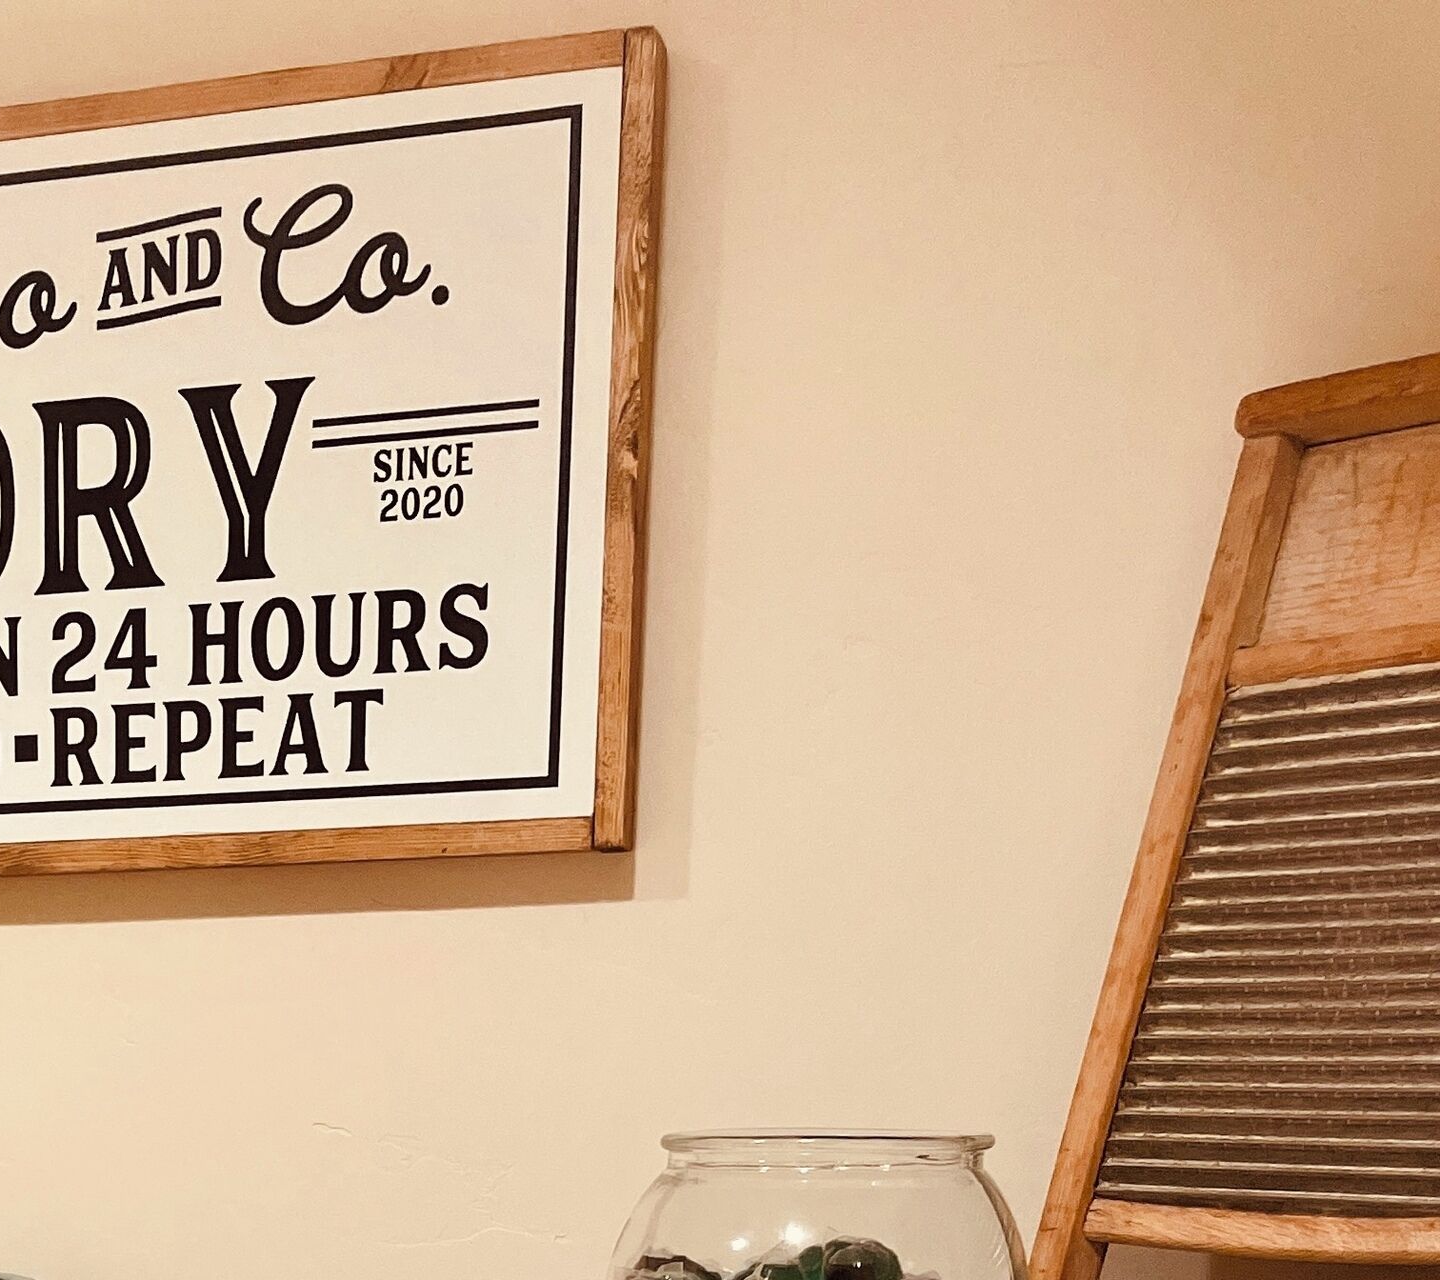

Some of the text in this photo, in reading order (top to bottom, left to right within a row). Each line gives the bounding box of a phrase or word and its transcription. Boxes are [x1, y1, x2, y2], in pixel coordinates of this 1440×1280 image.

[98, 229, 222, 311] AND
[243, 183, 450, 326] Co.
[373, 442, 474, 483] SINCE
[379, 484, 465, 523] 2020
[51, 611, 158, 695] 24
[188, 583, 490, 686] HOURS
[50, 688, 384, 788] REPEAT
